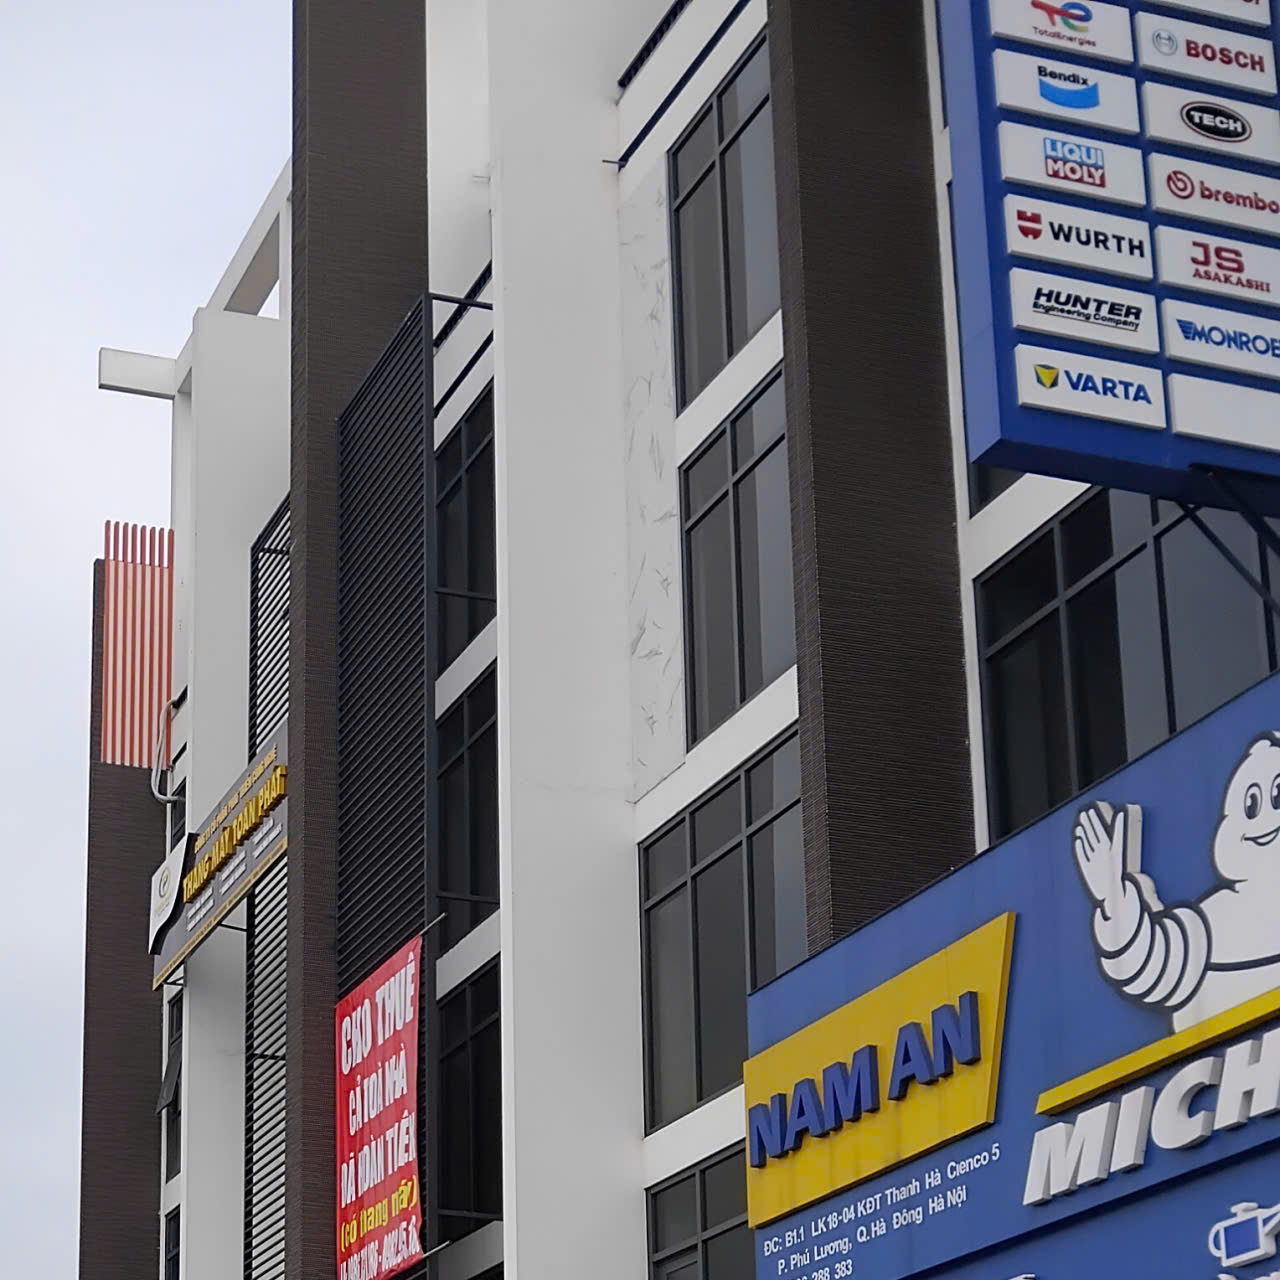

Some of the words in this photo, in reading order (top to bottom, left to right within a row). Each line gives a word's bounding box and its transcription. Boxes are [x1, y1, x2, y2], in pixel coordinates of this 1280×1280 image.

[1032, 26, 1097, 48] TotalEnergies
[1185, 39, 1265, 73] BOSCH
[1037, 65, 1089, 87] Bendix
[1190, 111, 1244, 134] TECH
[1043, 137, 1105, 166] LIQUI
[1046, 158, 1106, 189] MOLY
[1200, 182, 1280, 214] brembo
[1191, 241, 1245, 274] JS
[1192, 268, 1271, 293] ASAKASHI
[1032, 301, 1091, 320] Engineering
[1093, 313, 1140, 331] Company
[1033, 287, 1142, 321] HUNTER
[1064, 369, 1152, 404] VARTA
[341, 998, 372, 1075] CHO
[375, 951, 416, 1046] THUÊ
[349, 1074, 363, 1136] CẢ
[363, 1062, 383, 1123] TOÀ
[384, 1043, 407, 1107] NHÀ
[748, 1043, 880, 1169] NAM
[888, 990, 981, 1101] AN
[764, 1240, 783, 1257] ĐC:
[857, 1193, 882, 1219] KĐT
[884, 1179, 920, 1206] Thanh
[925, 1168, 941, 1190] Hà
[946, 1152, 989, 1180] Cienco
[991, 1142, 1000, 1161] 5
[777, 1259, 788, 1276] P.
[790, 1248, 810, 1272] Phú
[814, 1236, 853, 1262] Lương,
[892, 1206, 923, 1230] Đông
[928, 1195, 944, 1216] Hà
[947, 1185, 967, 1208] Nội
